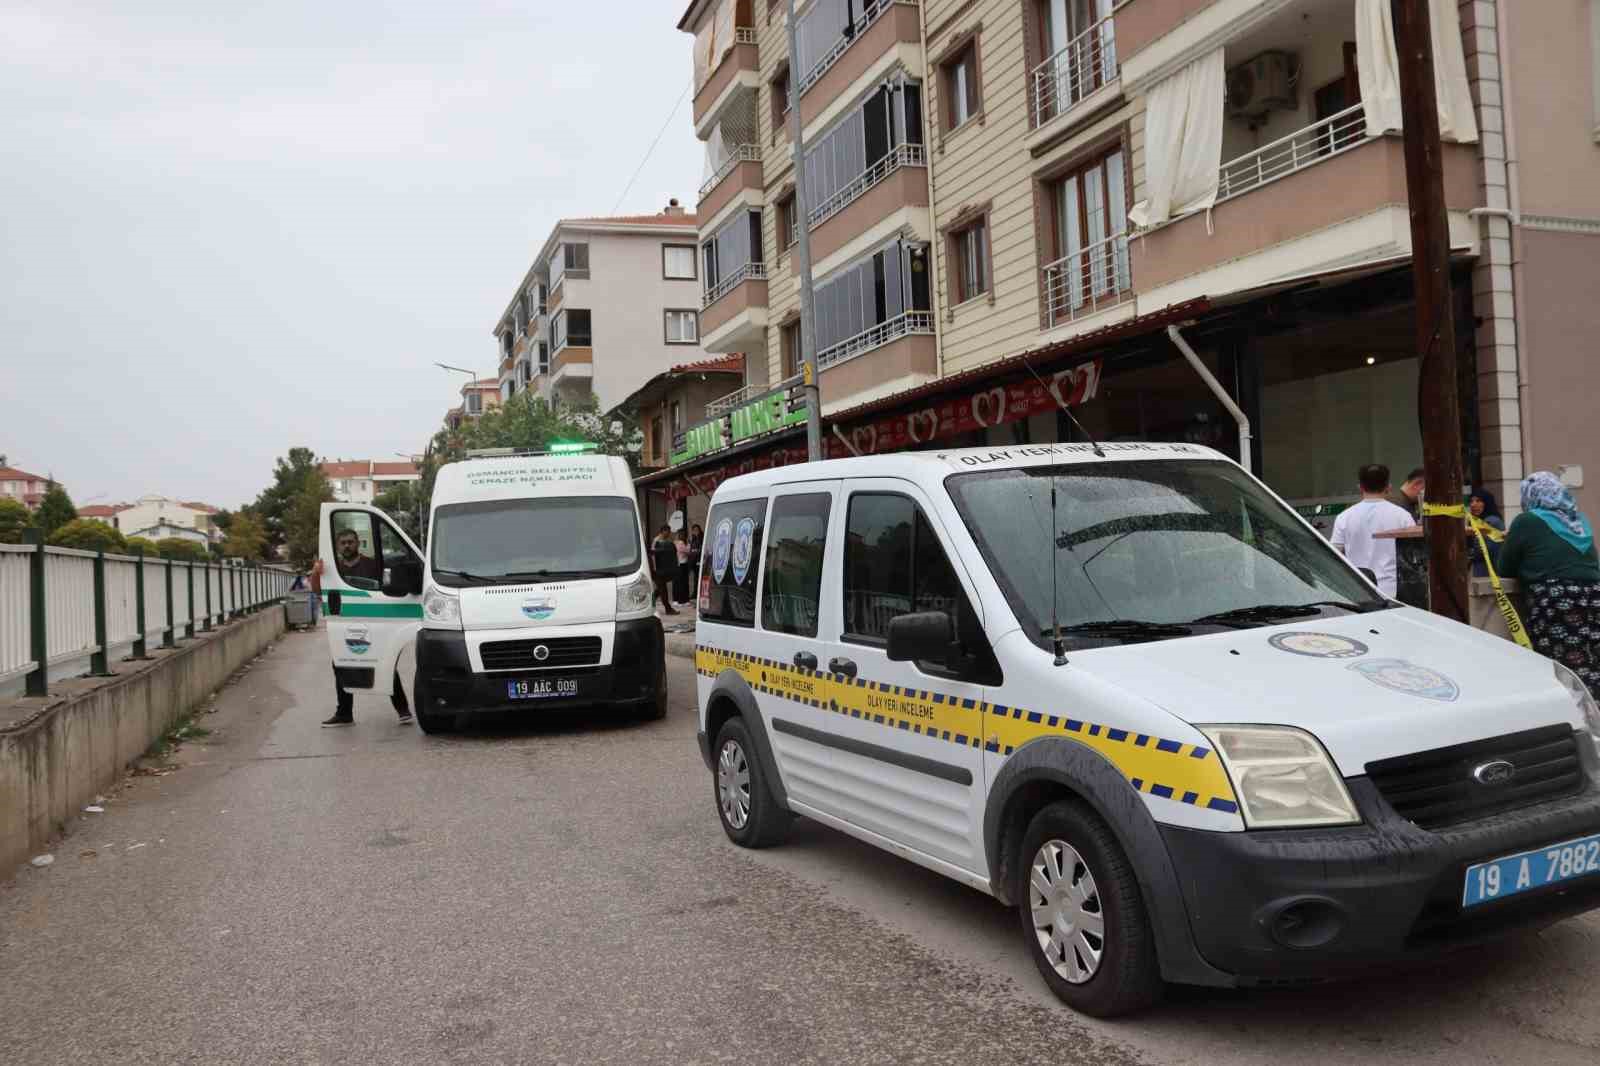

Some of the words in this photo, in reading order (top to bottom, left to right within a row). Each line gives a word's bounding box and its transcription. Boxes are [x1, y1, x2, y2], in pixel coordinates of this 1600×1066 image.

[960, 449, 1013, 466] OLAY
[471, 476, 516, 486] CENAZE
[516, 682, 528, 694] 19
[533, 681, 552, 693] AAC
[557, 680, 576, 692] 009
[867, 694, 883, 709] OLAY
[1478, 864, 1500, 899] 19
[1516, 857, 1531, 889] A
[1546, 841, 1600, 882] 7882
